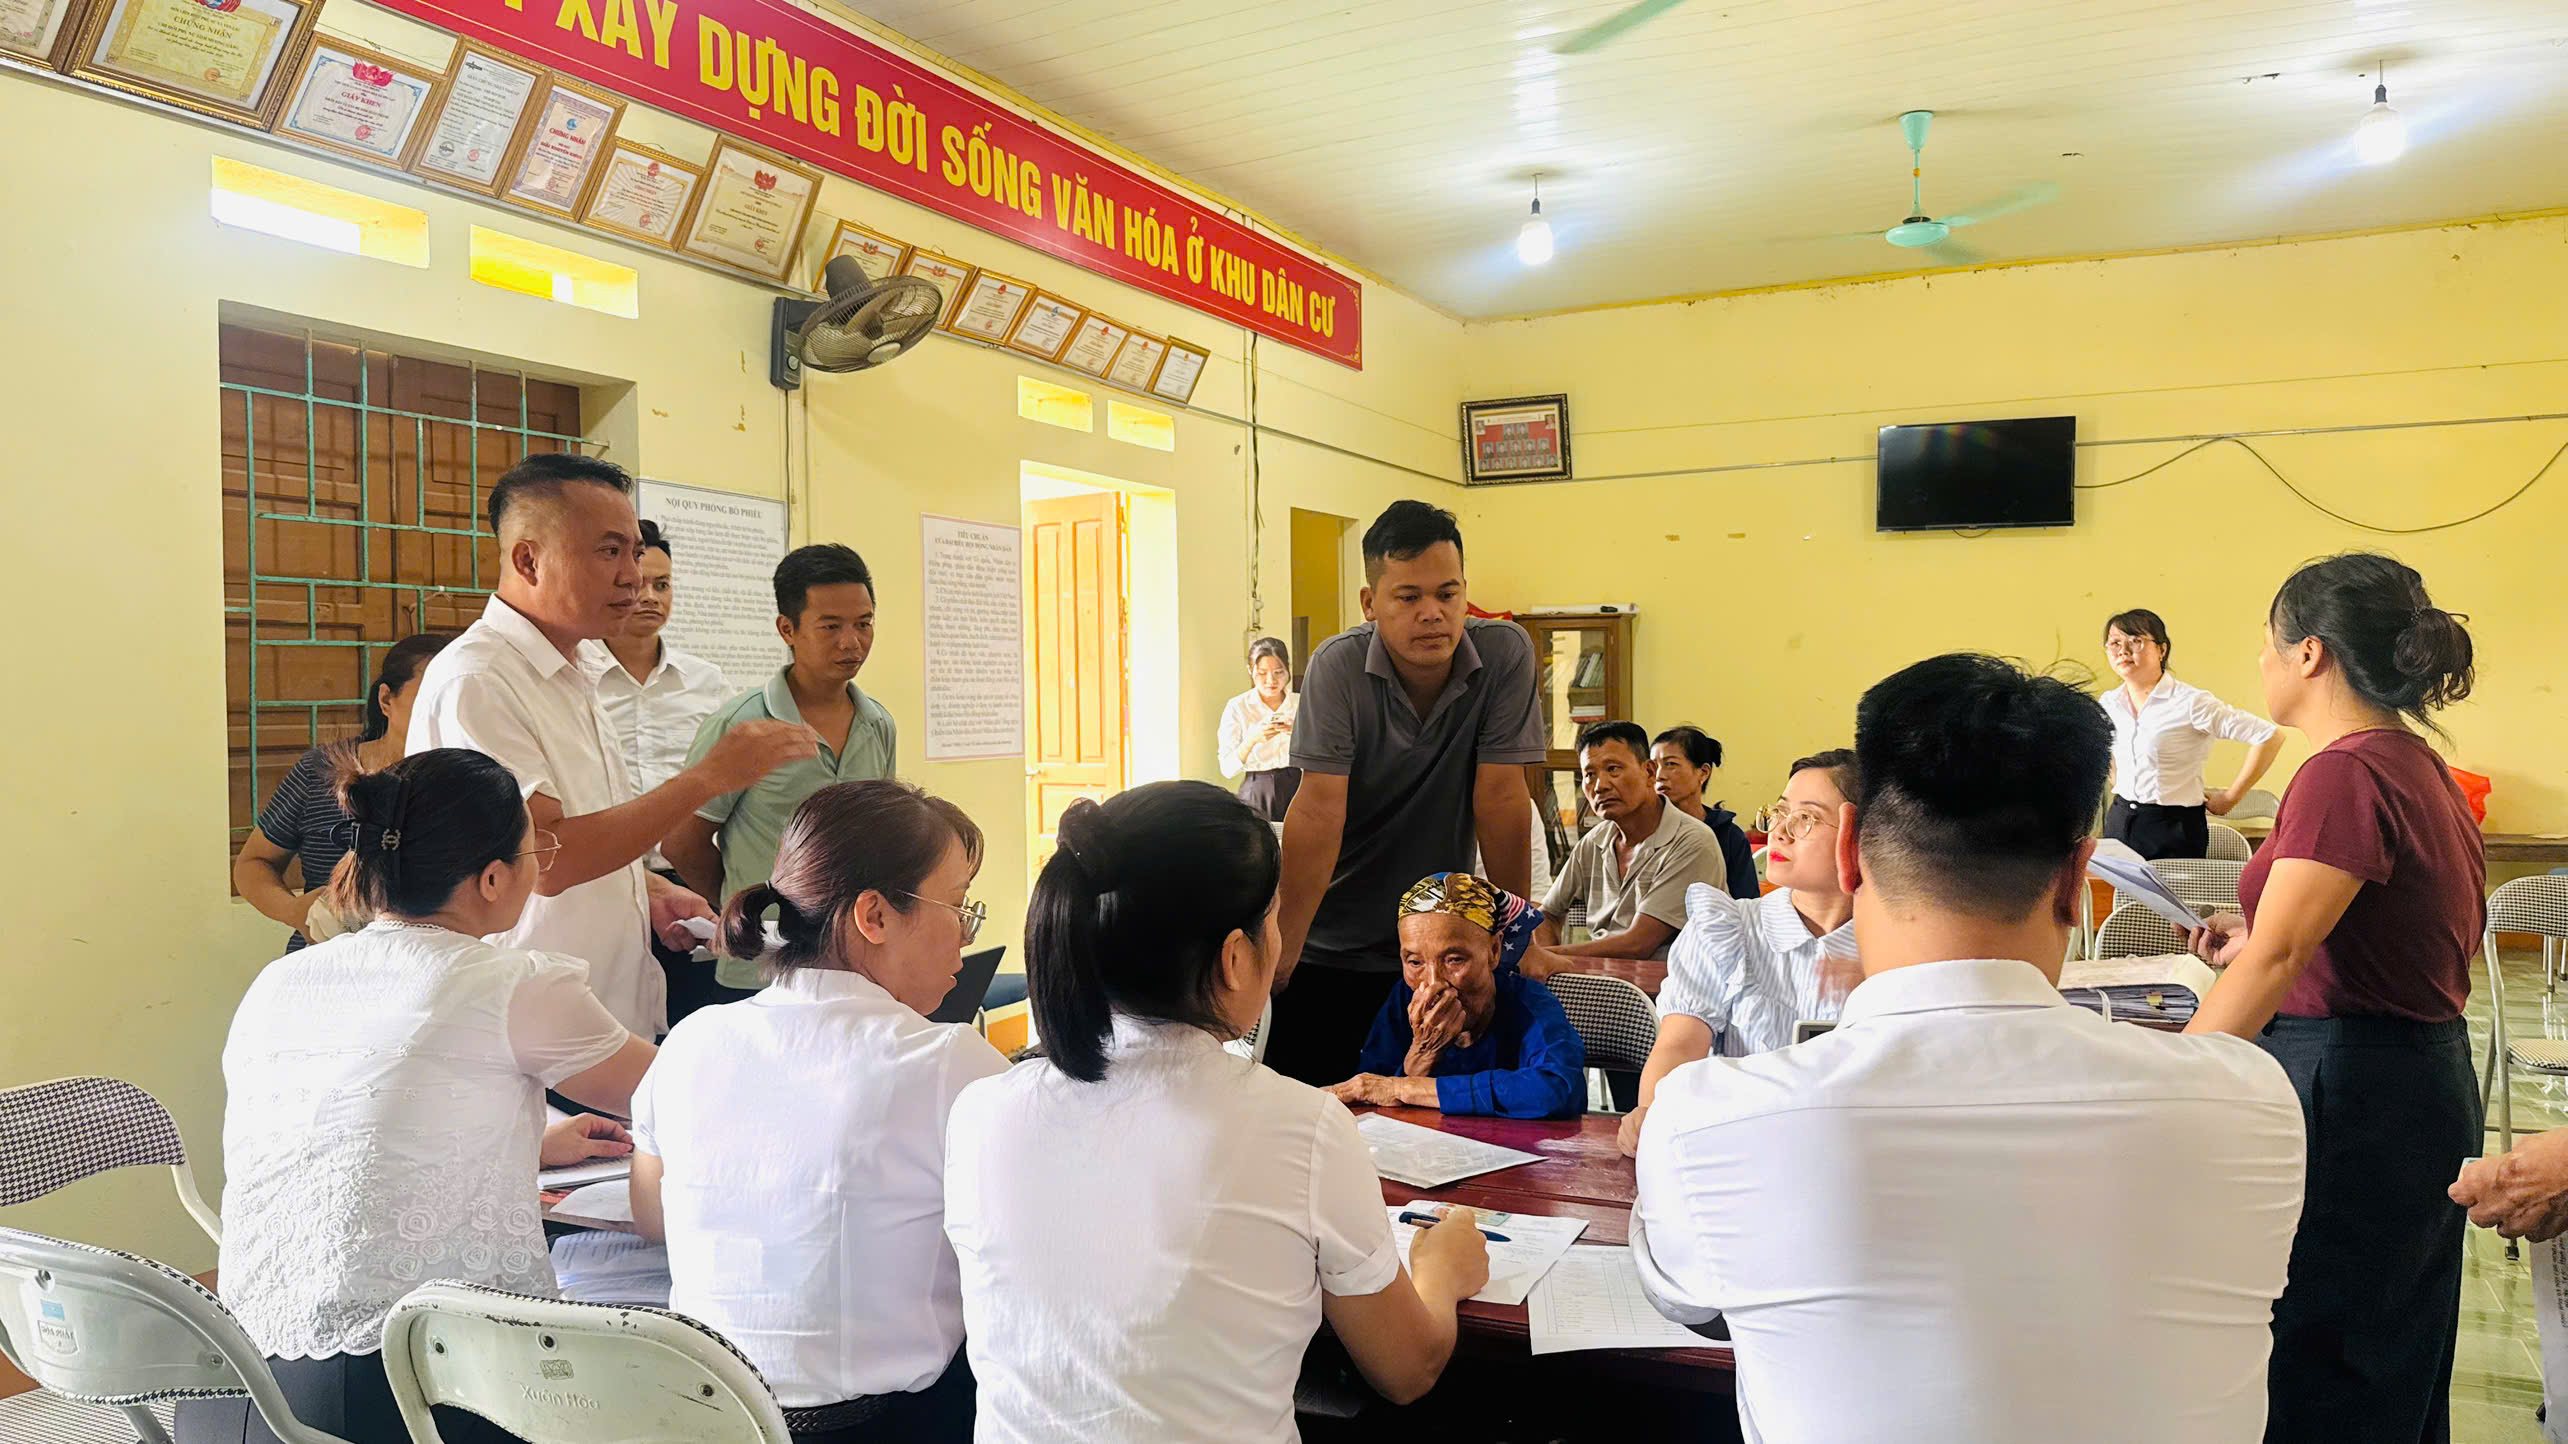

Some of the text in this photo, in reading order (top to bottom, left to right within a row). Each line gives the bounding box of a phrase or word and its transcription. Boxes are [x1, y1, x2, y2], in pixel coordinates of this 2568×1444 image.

[698, 14, 841, 137] DỰNG
[855, 83, 928, 173] ĐỜI
[941, 122, 1043, 220] SỐNG
[1051, 172, 1116, 250] VĂN
[1124, 206, 1180, 276] HÓA
[1186, 215, 1204, 284] Ở
[1209, 244, 1256, 306] KHU
[1262, 267, 1305, 326] DÂN
[1309, 290, 1336, 338] CƯ
[665, 497, 680, 508] NỘI
[682, 500, 698, 510] QUY
[520, 1382, 601, 1410] Xuân Hòa
